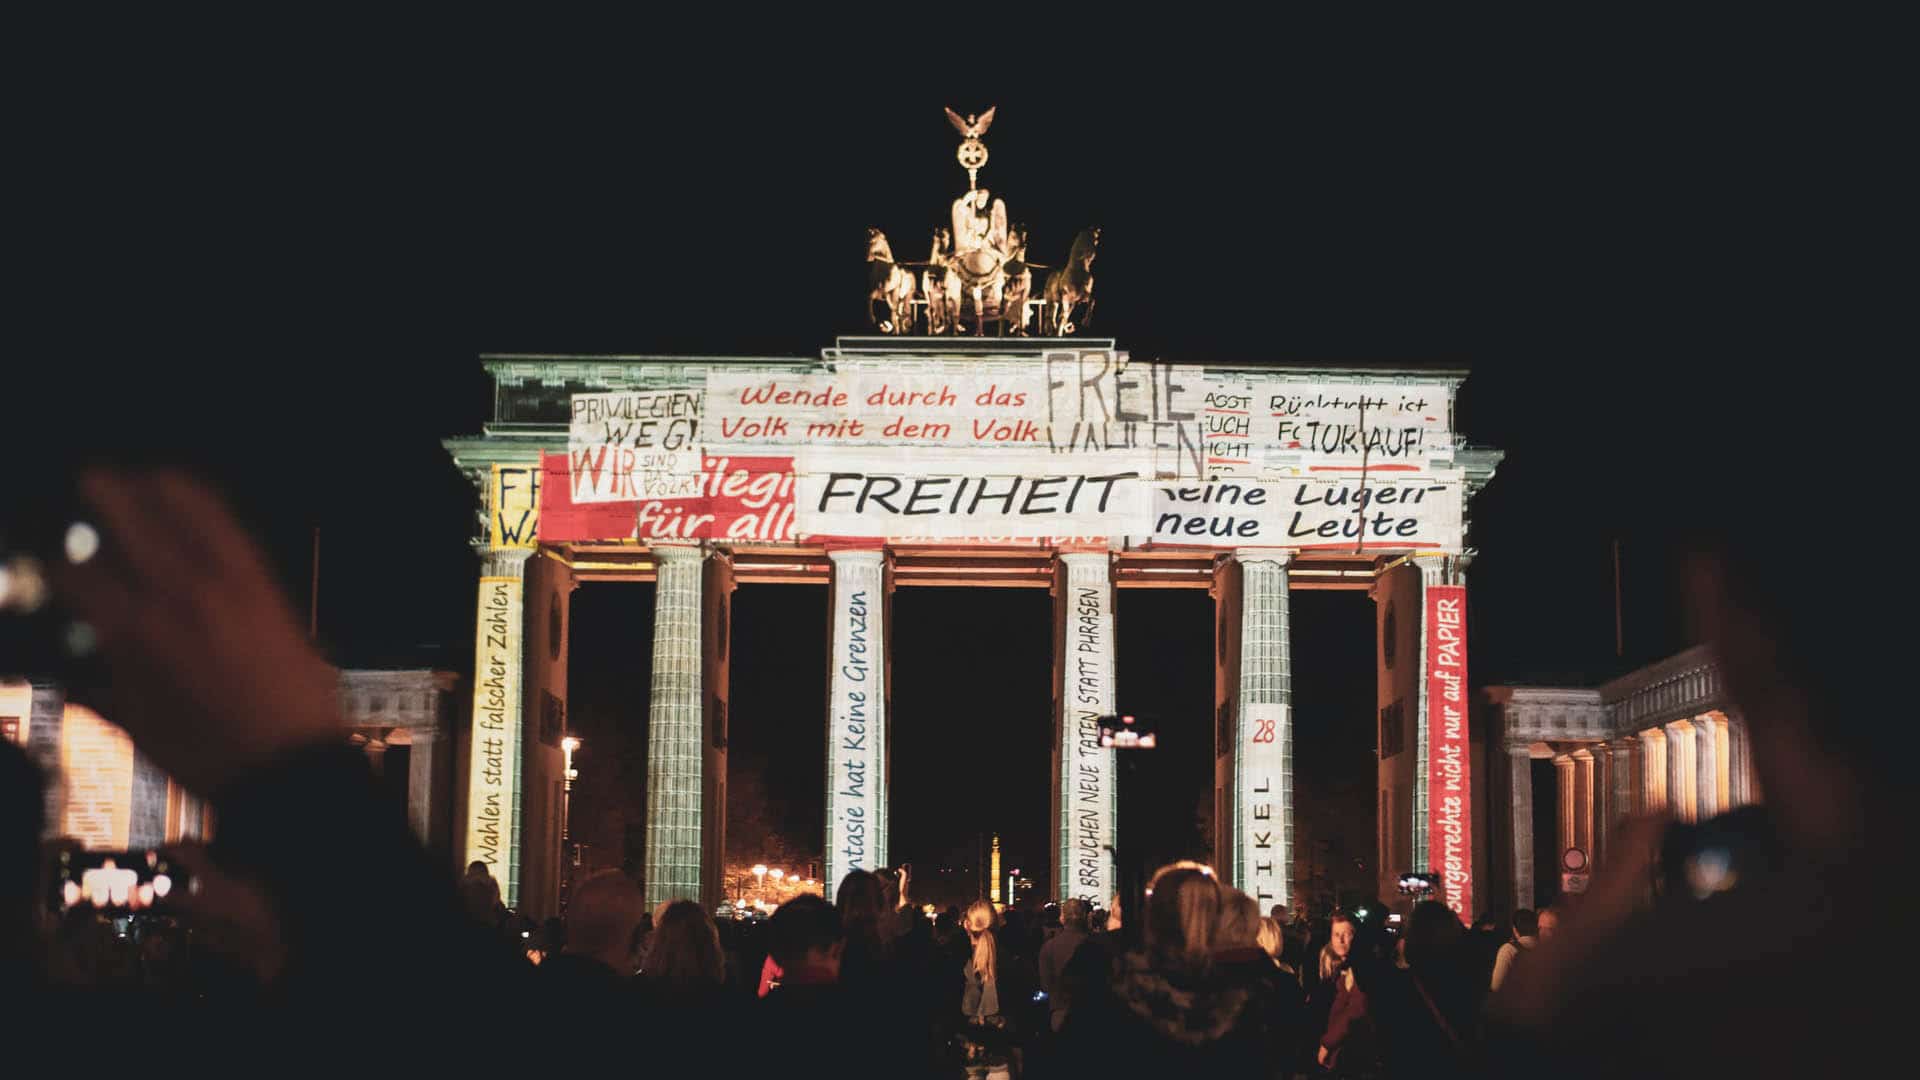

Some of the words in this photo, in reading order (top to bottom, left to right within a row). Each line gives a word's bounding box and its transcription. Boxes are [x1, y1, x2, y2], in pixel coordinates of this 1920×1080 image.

[740, 383, 848, 406] Wende
[866, 384, 957, 407] durch
[975, 385, 1027, 407] das
[1047, 351, 1195, 423] FREIE
[605, 419, 698, 451] WEG!
[721, 416, 789, 439] Volk
[807, 418, 864, 438] mit
[883, 416, 950, 438] dem
[973, 419, 1039, 442] Volk
[1366, 426, 1425, 457] AUF!
[572, 445, 637, 497] WIR
[641, 453, 678, 467] SIND
[818, 472, 1138, 515] FREIHEIT
[632, 502, 715, 539] für
[1155, 512, 1260, 538] neue
[1288, 511, 1419, 539] Leute
[487, 583, 509, 651] Zahlen
[842, 591, 869, 682] Grenzen
[1078, 588, 1100, 655] PHRASEN
[1437, 597, 1460, 667] PAPIER
[481, 656, 507, 731] falscher
[1078, 657, 1100, 705] STATT
[1435, 669, 1461, 703] auf
[1077, 710, 1100, 758] TATEN
[1253, 719, 1276, 744] 28
[1445, 709, 1461, 740] nur
[480, 738, 503, 787] statt
[840, 759, 866, 798] hat
[1078, 763, 1100, 805] NEUE
[1437, 744, 1461, 793] nicht
[477, 793, 501, 866] Wahlen
[1078, 808, 1099, 889] BRAUCHEN
